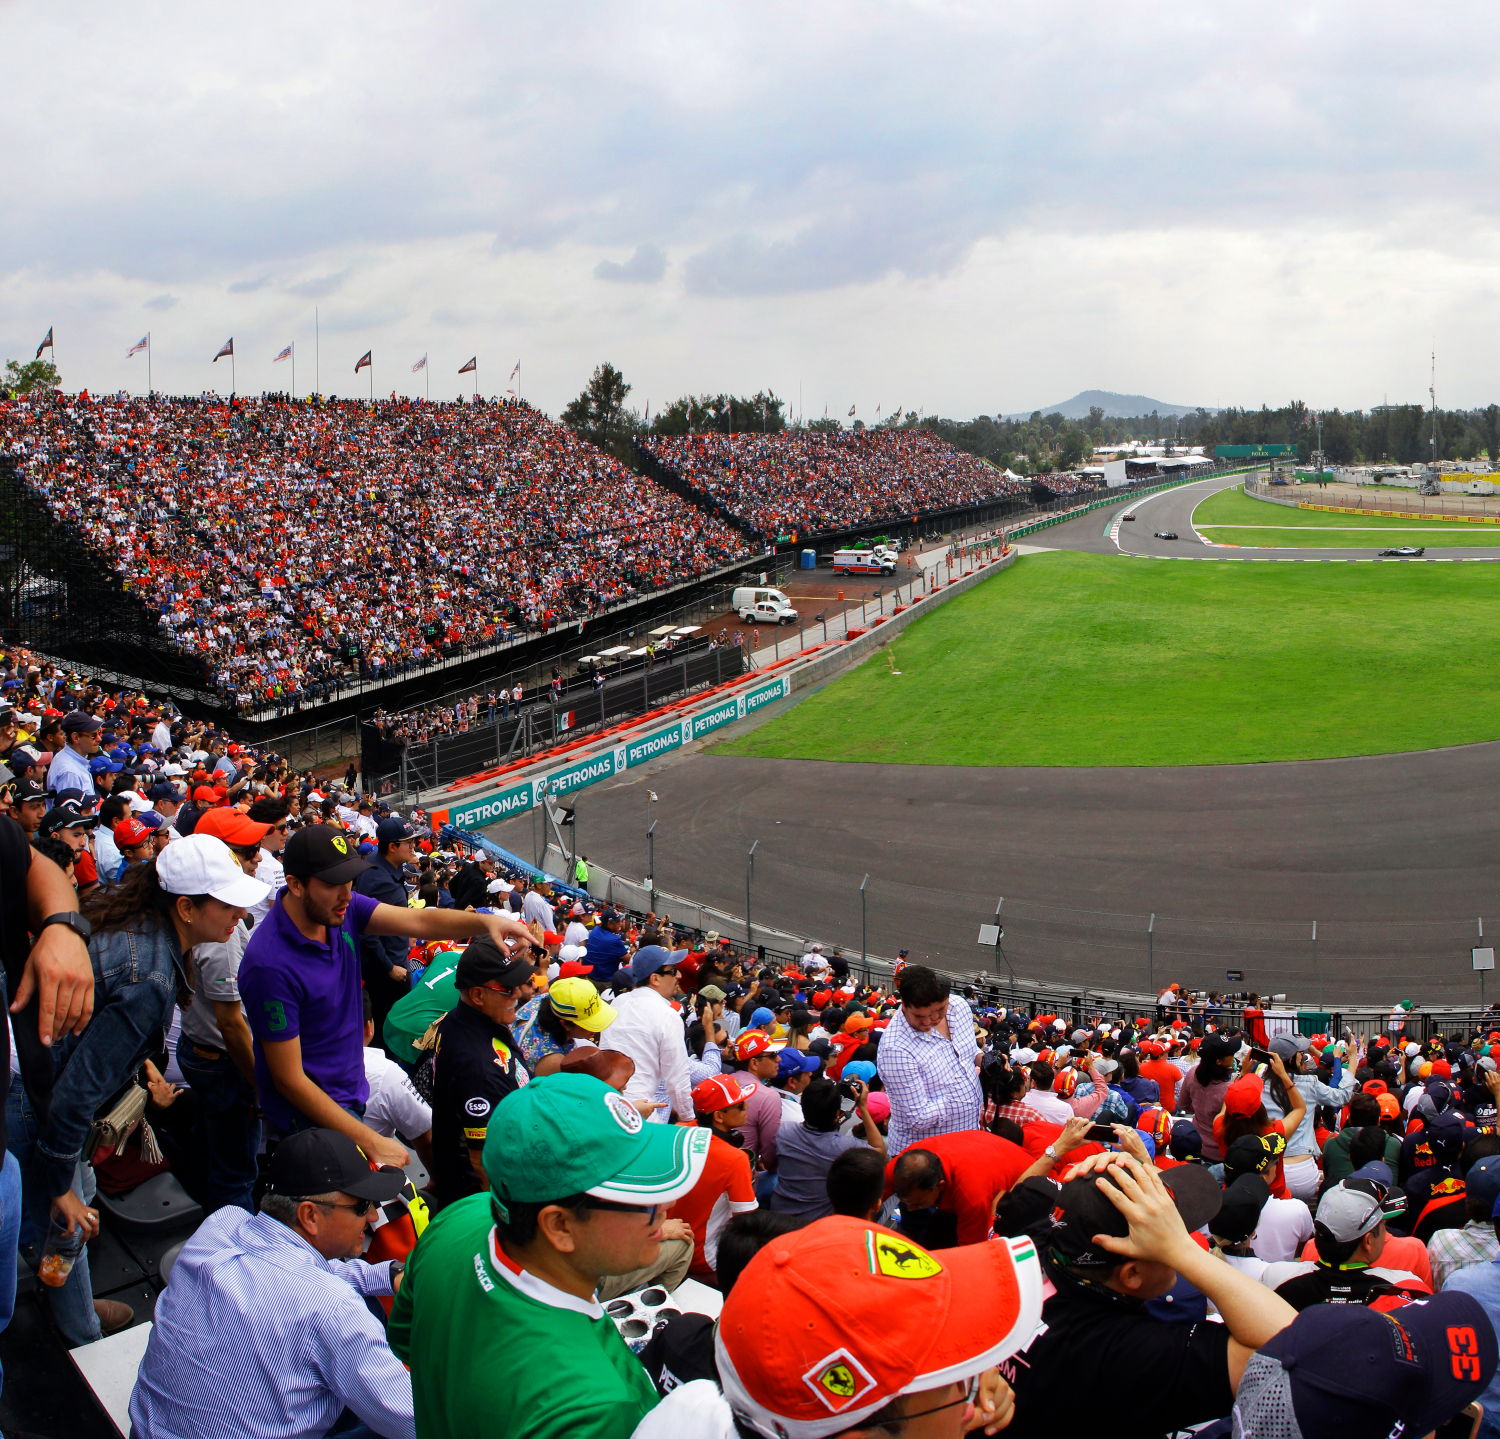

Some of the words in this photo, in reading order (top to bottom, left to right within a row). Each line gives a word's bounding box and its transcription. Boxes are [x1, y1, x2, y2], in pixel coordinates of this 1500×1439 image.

[747, 684, 782, 709] PETRONAS
[694, 705, 736, 733] PETRONAS
[629, 730, 680, 762] PETRONAS
[551, 759, 611, 793] PETRONAS
[455, 791, 529, 827] PETRONAS
[263, 1000, 288, 1031] 3
[473, 1253, 495, 1293] MÉXICO
[1446, 1325, 1481, 1381] 33
